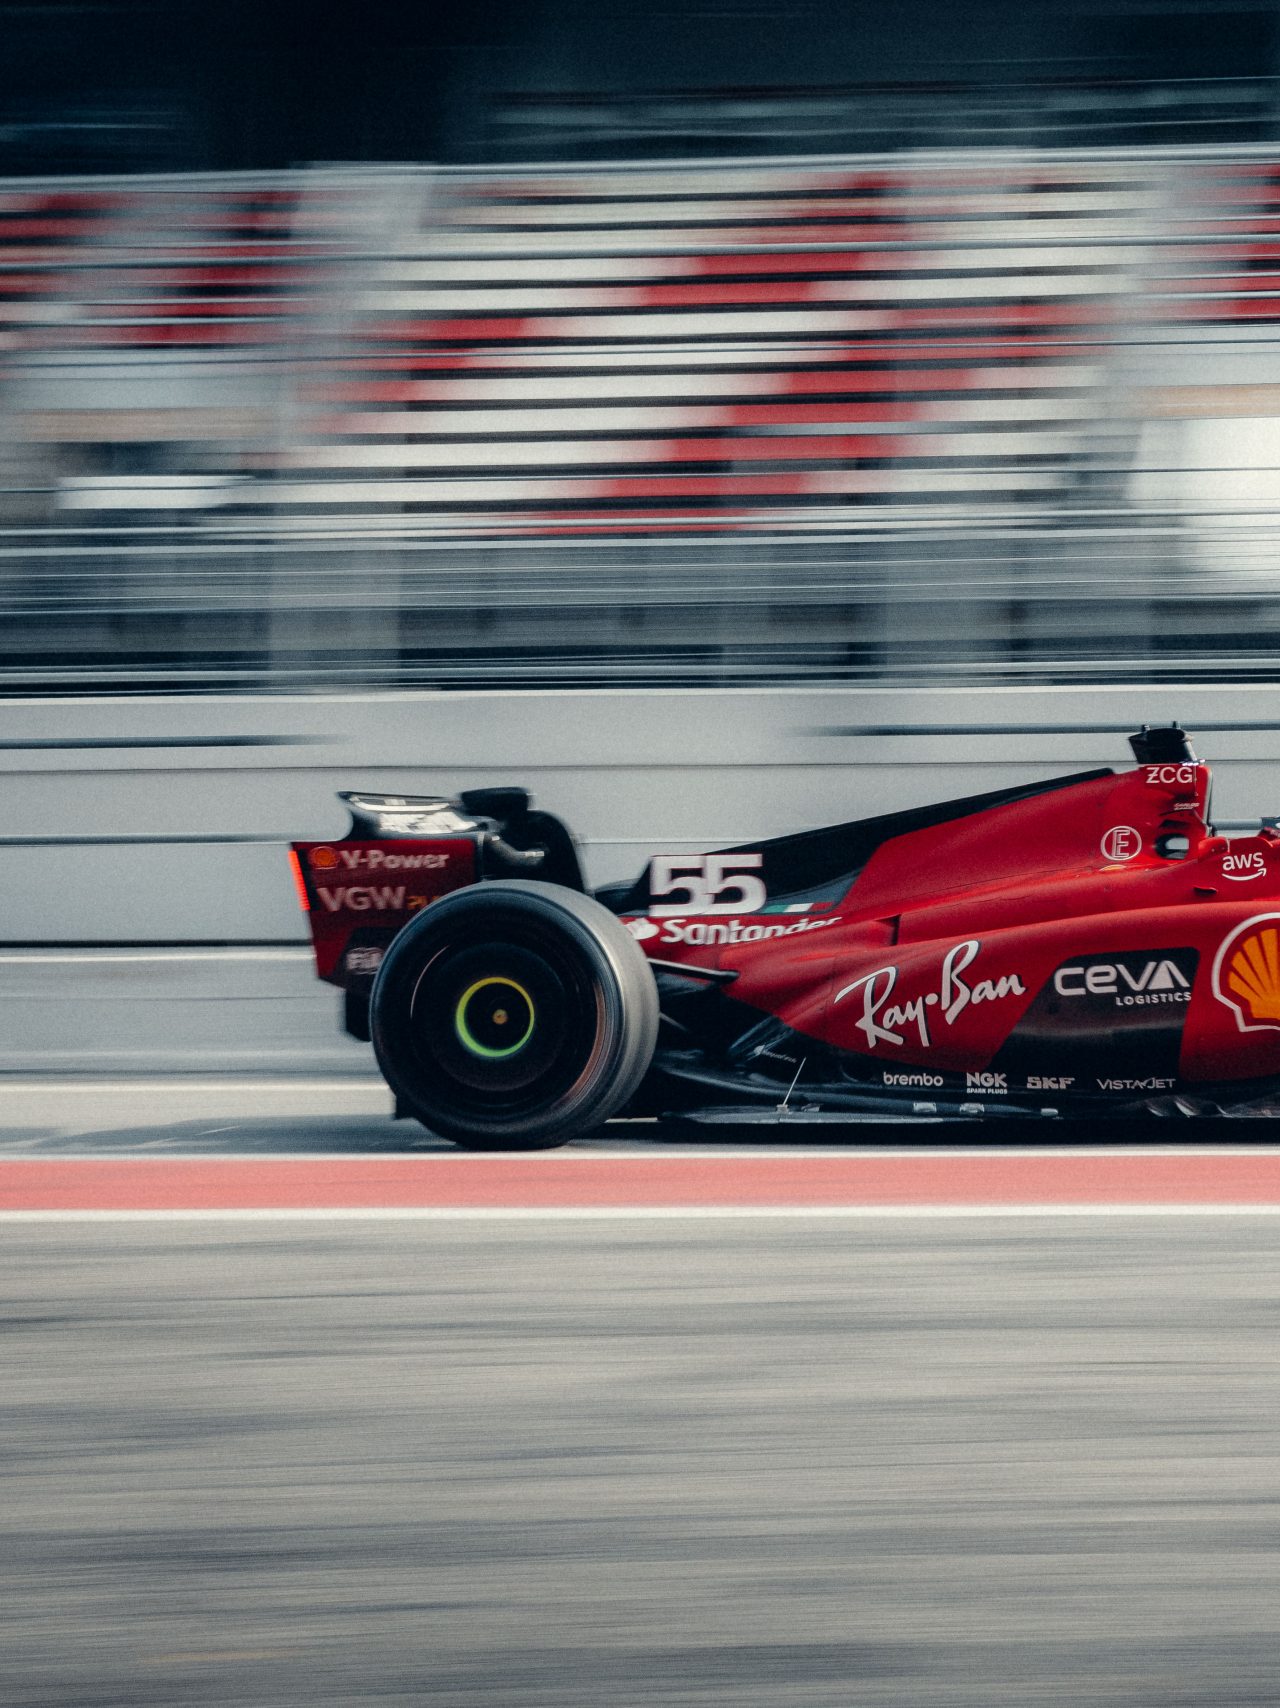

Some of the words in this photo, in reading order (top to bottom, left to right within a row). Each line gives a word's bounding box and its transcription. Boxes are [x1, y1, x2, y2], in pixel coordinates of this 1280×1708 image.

[1146, 766, 1193, 784] ZCG
[340, 849, 450, 869] V-Power
[1222, 851, 1265, 872] aws
[649, 854, 767, 917] 55
[316, 886, 406, 912] VGW
[659, 917, 842, 945] Santander
[1115, 991, 1192, 1006] LOGISTICS
[883, 1071, 944, 1087] brembo
[966, 1072, 1008, 1088] NGK
[1026, 1076, 1076, 1090] SKF
[966, 1087, 987, 1095] SPARK
[987, 1088, 1008, 1096] PLUGS
